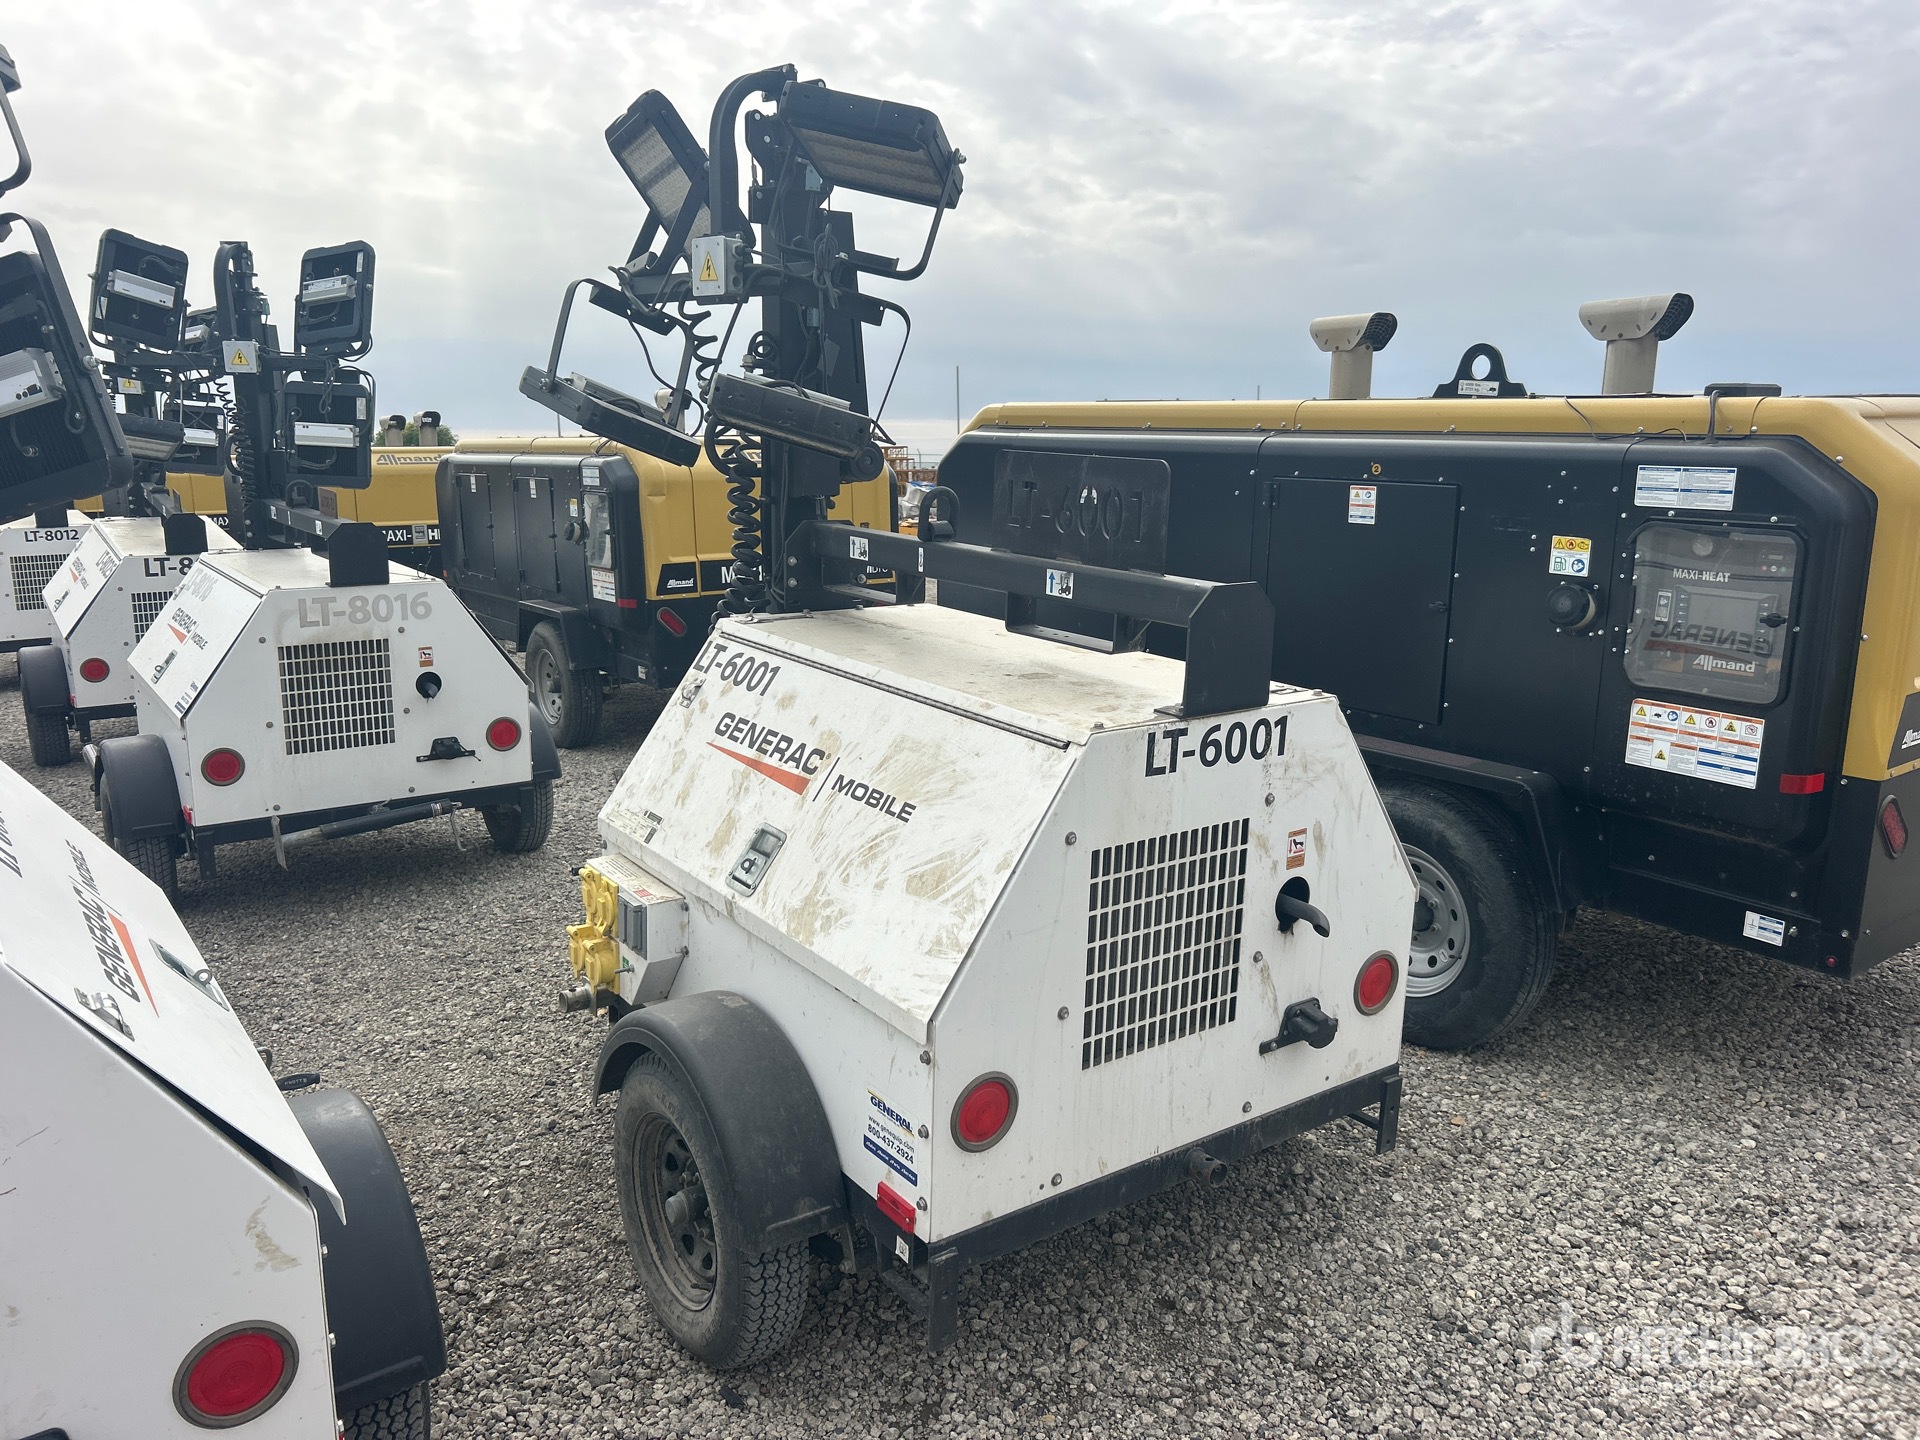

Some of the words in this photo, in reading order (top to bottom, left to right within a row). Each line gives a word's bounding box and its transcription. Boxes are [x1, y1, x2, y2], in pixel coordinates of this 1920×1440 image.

[1007, 479, 1144, 543] LT-6001
[24, 529, 80, 543] LT-8012
[143, 556, 199, 578] LT-8
[1672, 568, 1731, 583] MAXI-HEAT
[298, 591, 433, 629] LT-8016
[691, 640, 781, 697] LT-6001
[1692, 654, 1756, 673] Allmand
[1145, 714, 1289, 778] LT-6001
[714, 711, 829, 776] GENERAC
[830, 773, 917, 824] MOBILE
[65, 838, 99, 892] MOBILE
[73, 885, 141, 1003] GENERAC
[870, 1095, 913, 1133] GENERAL
[867, 1123, 914, 1165] 800-437-2924
